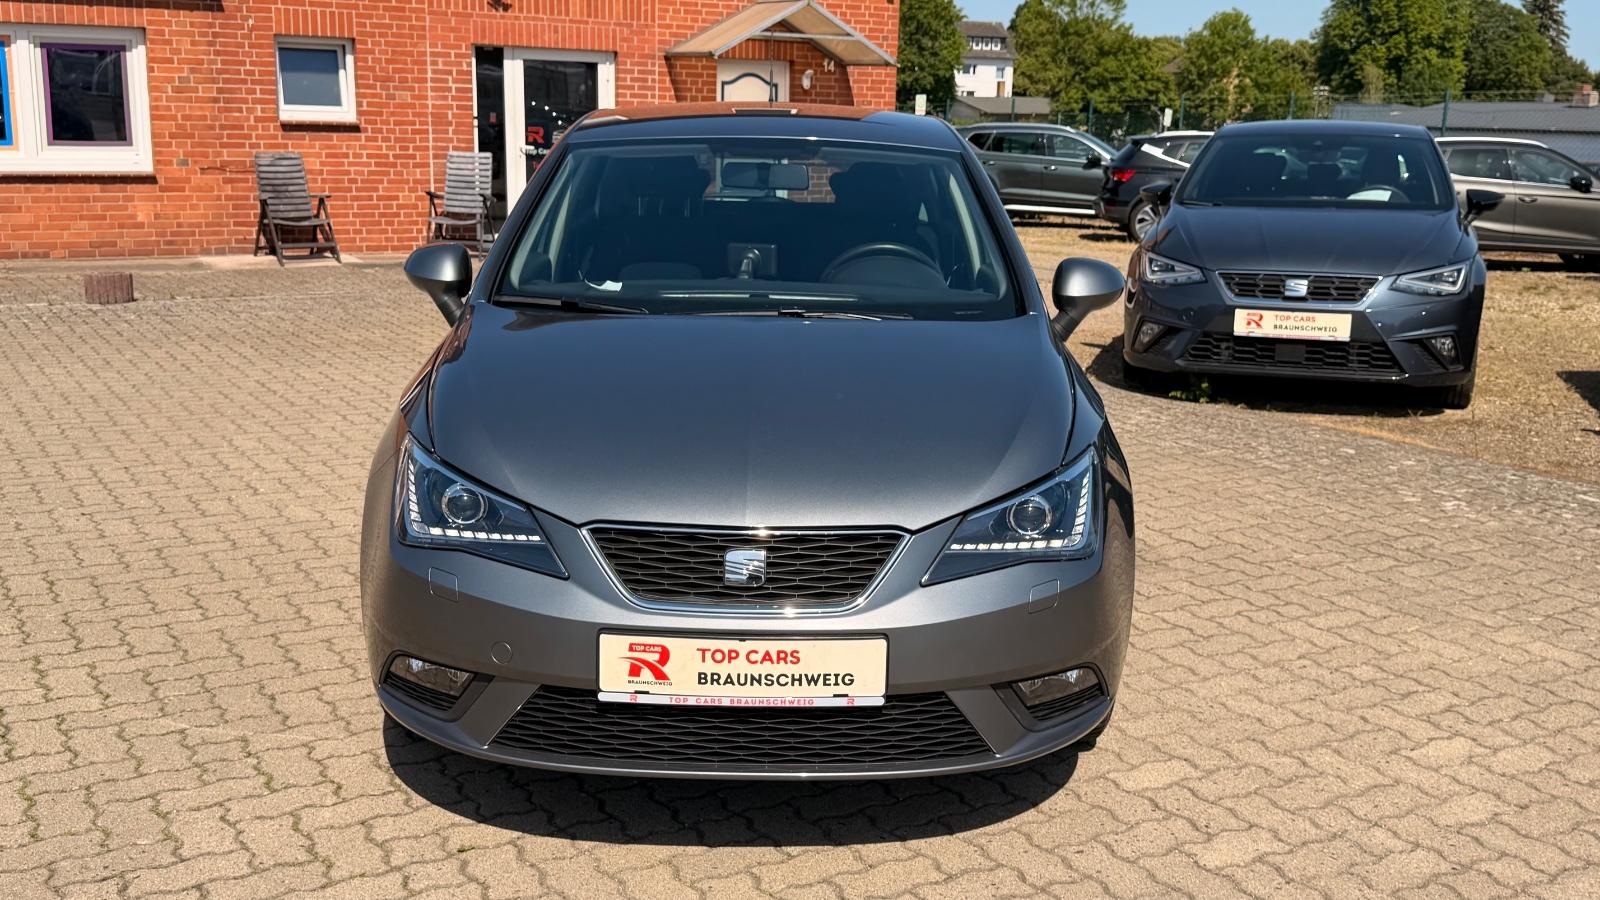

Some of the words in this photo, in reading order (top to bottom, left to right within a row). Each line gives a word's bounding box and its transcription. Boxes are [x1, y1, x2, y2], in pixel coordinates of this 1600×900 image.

[823, 58, 835, 73] 14
[1293, 315, 1316, 323] CARS
[1273, 324, 1338, 333] BRAUNSCHWEIG
[696, 647, 740, 665] TOP
[745, 648, 801, 665] CARS
[627, 679, 673, 687] BRAUNSCHWEIG
[697, 671, 855, 687] BRAUNSCHWEIG
[669, 697, 689, 705] TOP
[695, 697, 723, 705] CARS
[729, 697, 815, 706] BRAUNSCHWEIG
